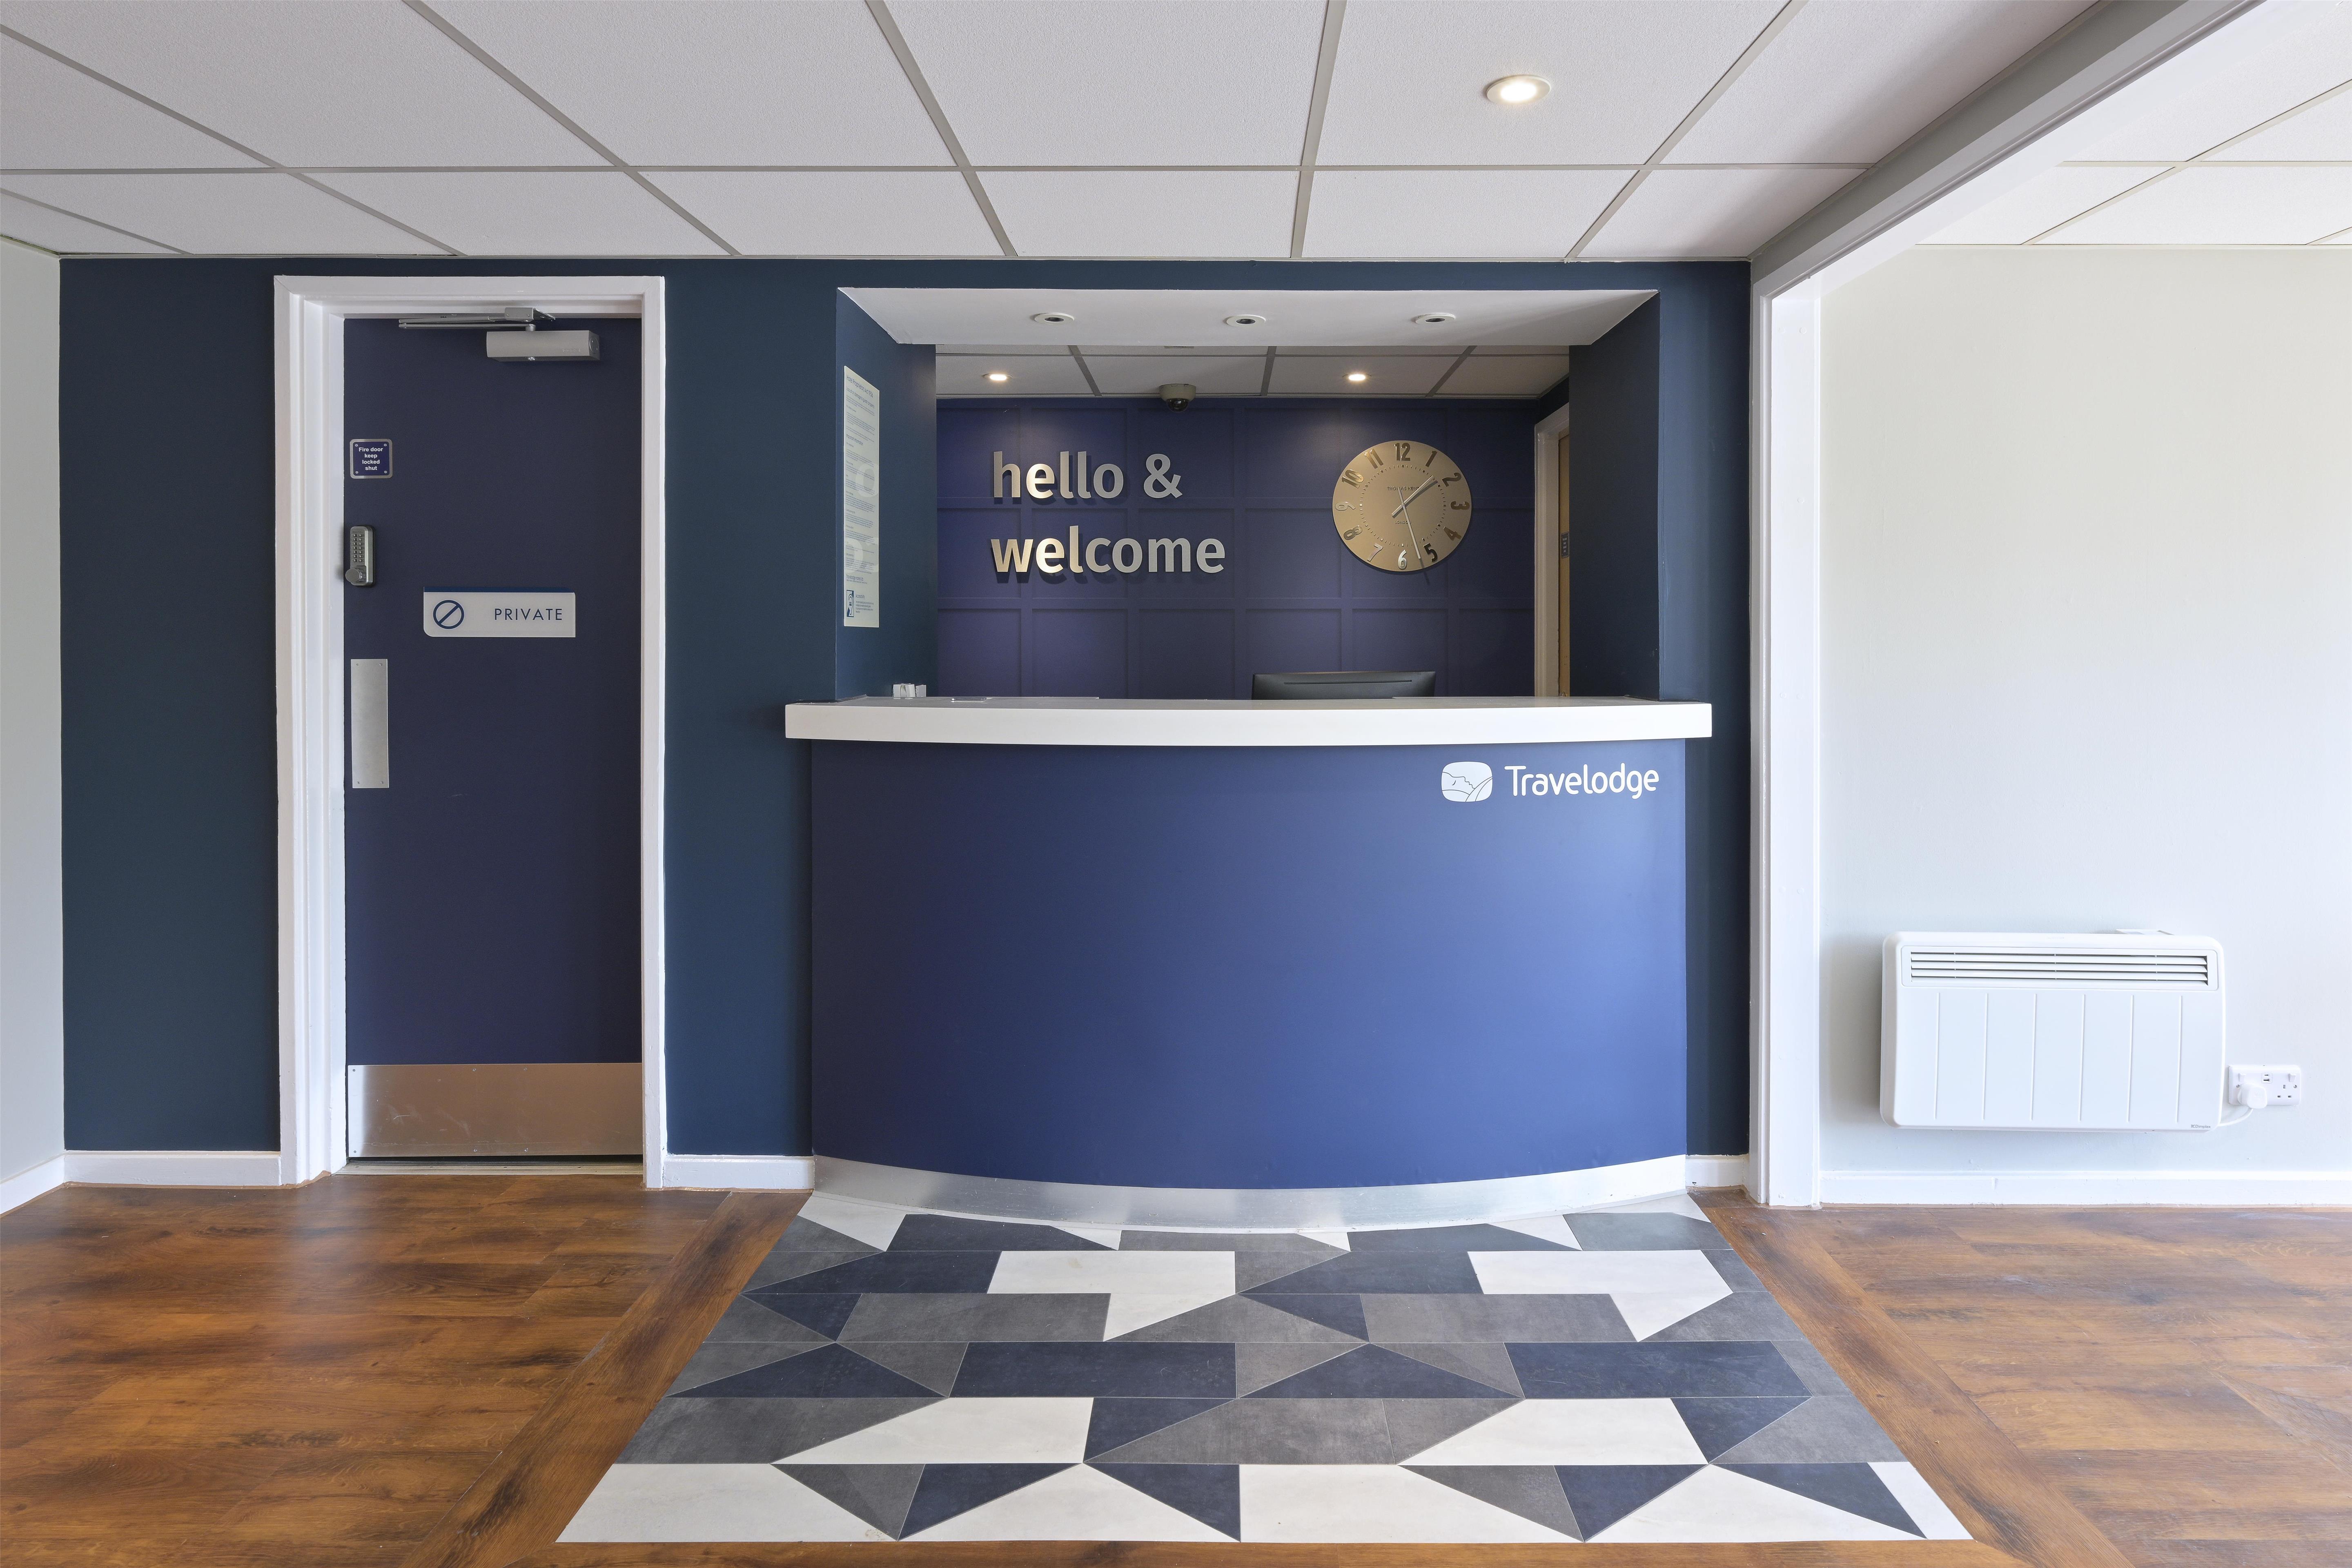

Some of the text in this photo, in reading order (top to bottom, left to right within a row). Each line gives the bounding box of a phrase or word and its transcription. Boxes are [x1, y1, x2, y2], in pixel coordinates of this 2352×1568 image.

[1364, 448, 1384, 469] 11
[1394, 442, 1411, 461] 12
[1425, 450, 1438, 468] 1
[993, 451, 1183, 499] hello &
[1341, 469, 1365, 489] 10
[1441, 472, 1462, 487] 2
[1335, 501, 1356, 511] 9
[1450, 501, 1470, 510] 3
[1343, 525, 1363, 540] 8
[1443, 526, 1462, 541] 4
[991, 525, 1225, 573] welcome
[1367, 543, 1383, 562] 7
[1423, 543, 1438, 562] 5
[1398, 549, 1408, 570] 6
[494, 608, 562, 620] PRIVATE
[1504, 763, 1659, 799] Travelodge
